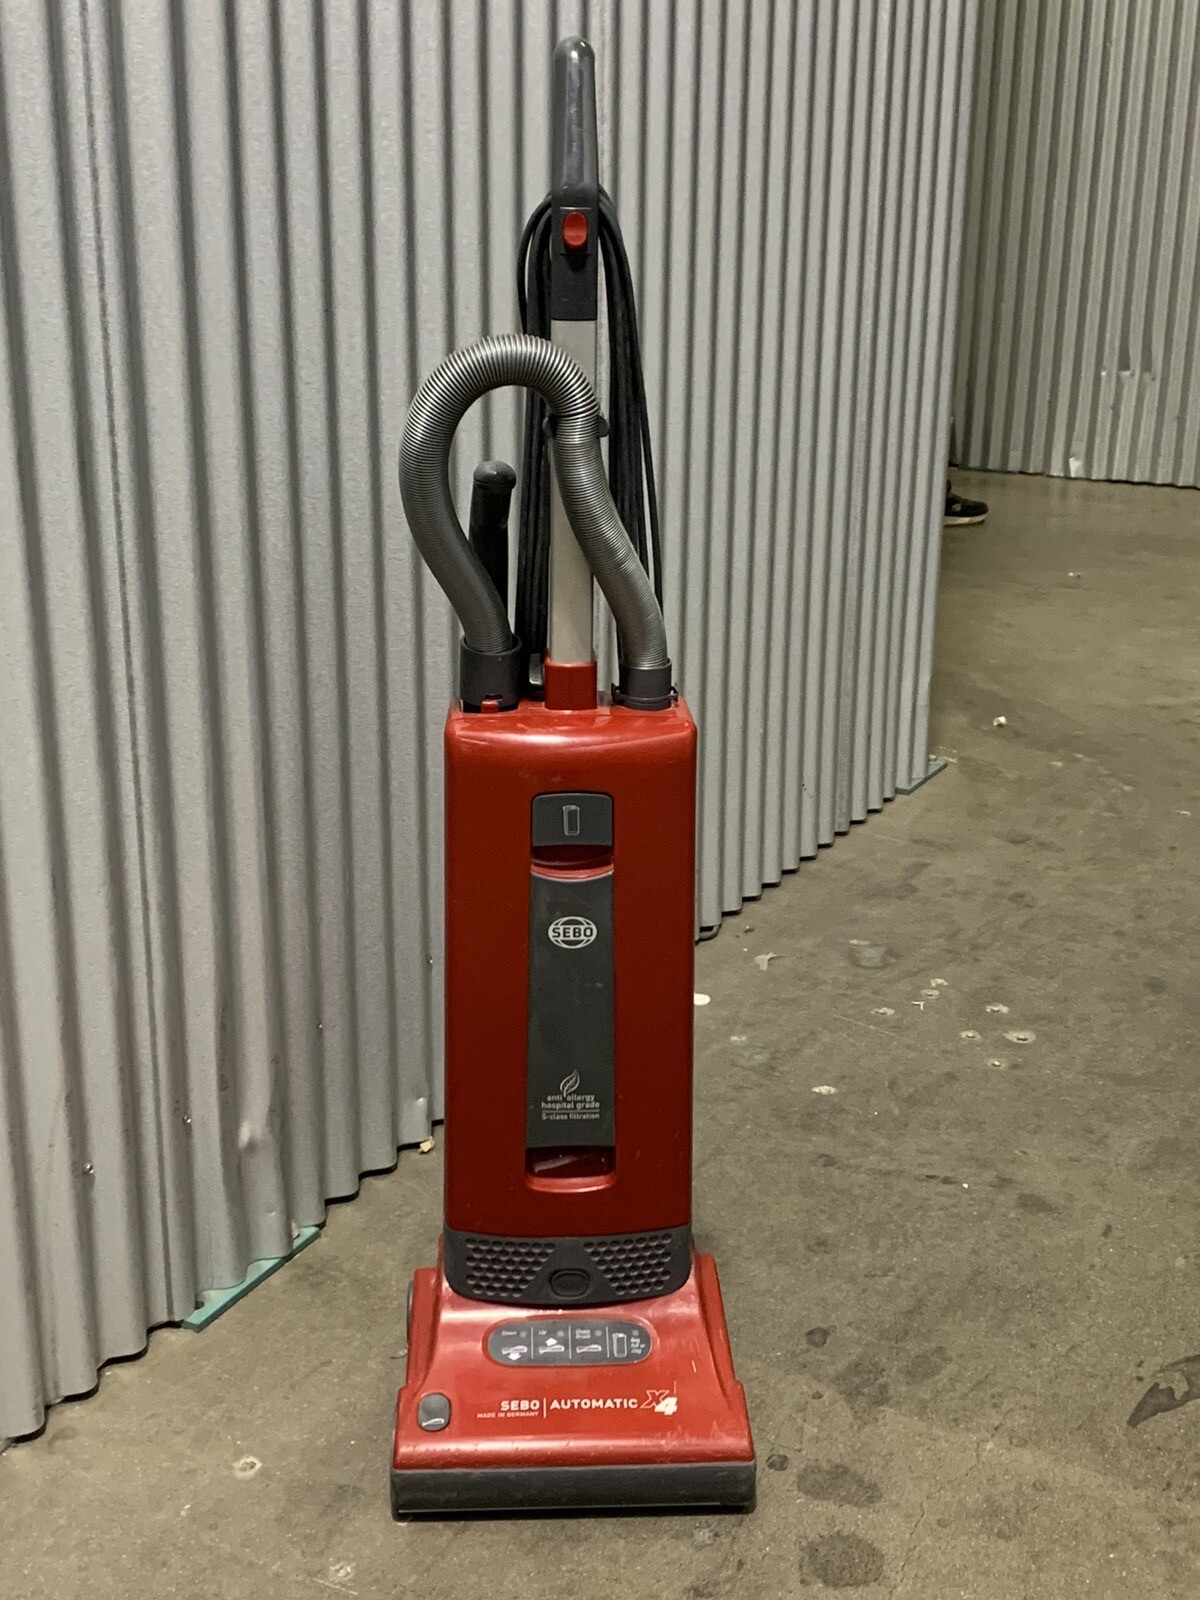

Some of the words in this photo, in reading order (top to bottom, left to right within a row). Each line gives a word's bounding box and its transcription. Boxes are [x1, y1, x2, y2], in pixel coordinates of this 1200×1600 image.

[551, 926, 594, 939] SEBO
[566, 1093, 595, 1102] allergy
[541, 1101, 574, 1109] hospital
[575, 1102, 600, 1110] grade
[500, 1399, 540, 1411] SEBO
[549, 1398, 639, 1410] AUTOMATIC
[640, 1389, 679, 1416] X4
[476, 1411, 496, 1419] MADE
[506, 1410, 540, 1418] GERMANY
